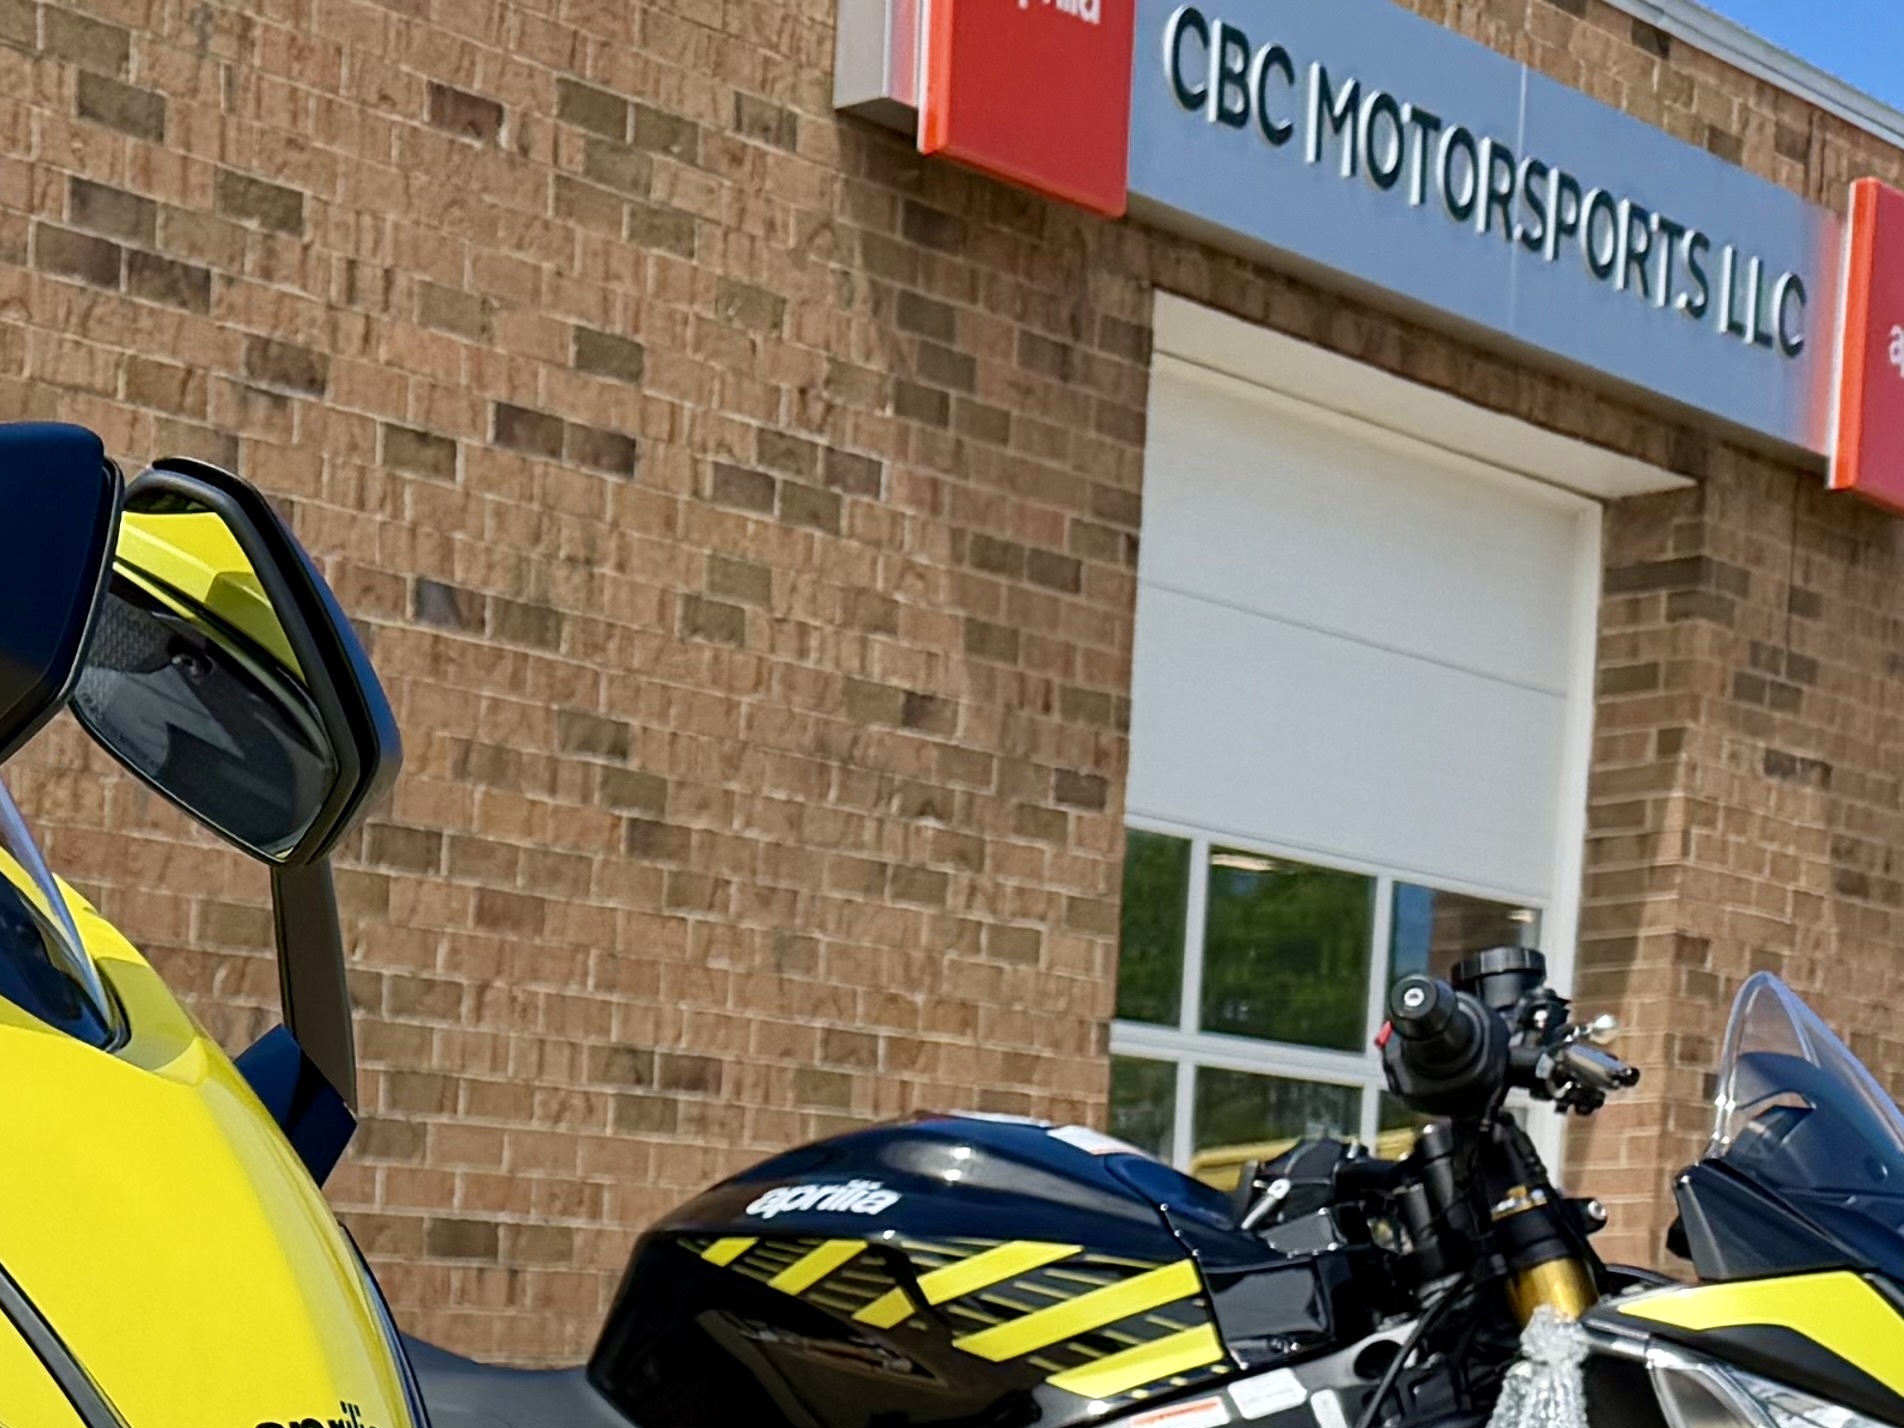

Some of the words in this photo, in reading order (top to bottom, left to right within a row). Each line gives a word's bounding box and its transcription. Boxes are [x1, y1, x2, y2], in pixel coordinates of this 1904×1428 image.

[1163, 2, 1296, 146] CBC
[1304, 59, 1710, 320] MOTORSPORTS
[1718, 243, 1807, 359] LLC
[746, 1179, 903, 1219] aprilia
